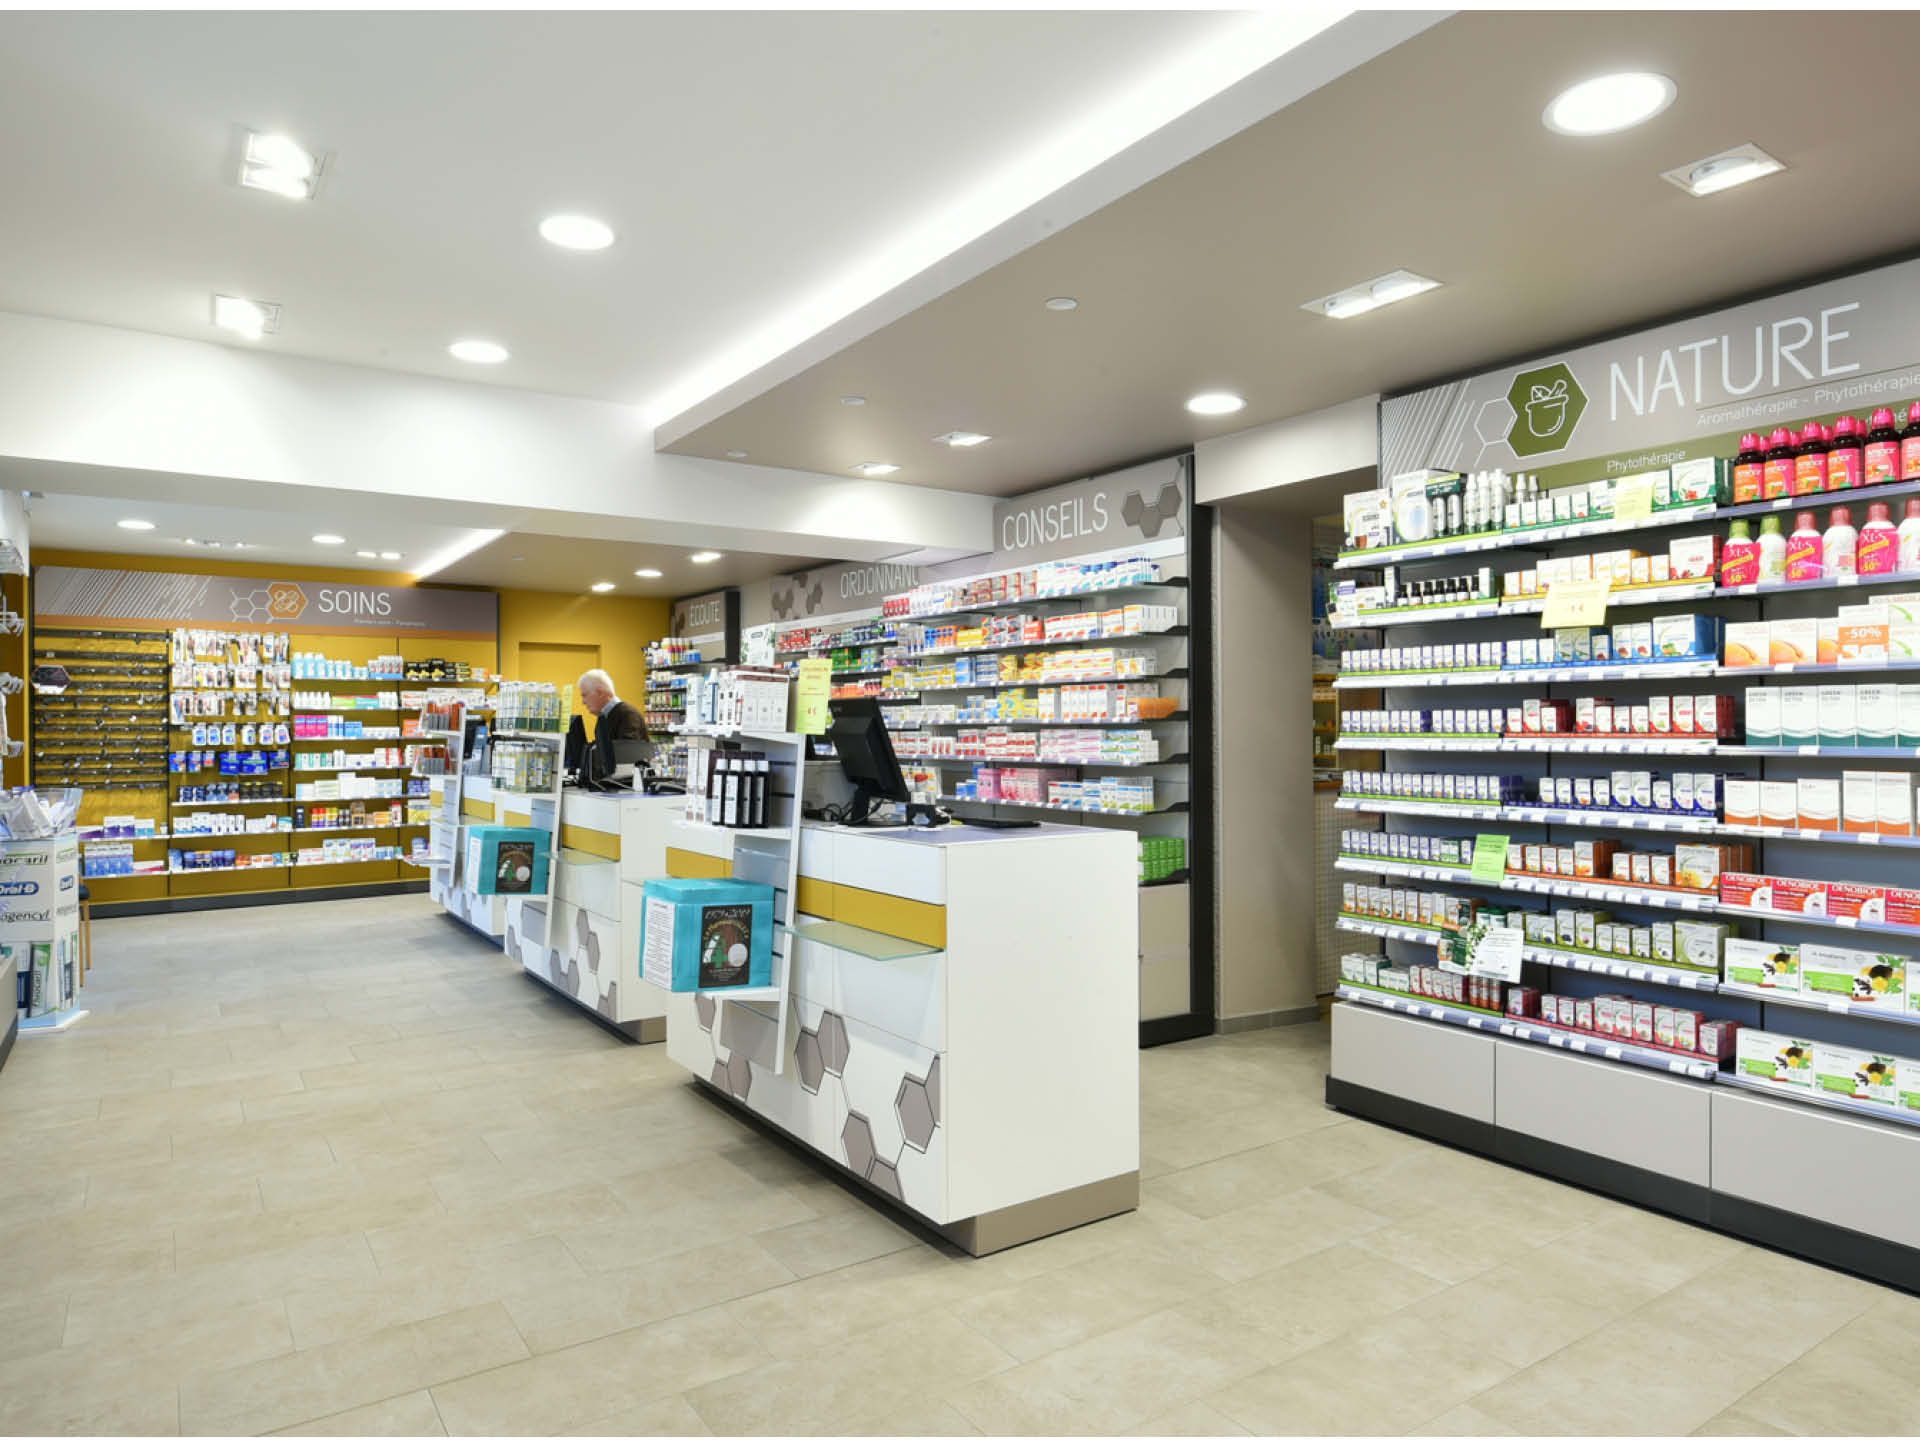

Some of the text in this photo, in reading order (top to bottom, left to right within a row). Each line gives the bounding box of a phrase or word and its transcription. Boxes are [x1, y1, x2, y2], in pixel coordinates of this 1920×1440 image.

[1610, 301, 1861, 421] NATURE
[1697, 398, 1799, 426] Aromathérapie
[1814, 372, 1920, 406] Phytothérapie
[1607, 450, 1686, 474] Phytothérapie
[1003, 492, 1109, 551] CONSEILS
[318, 589, 392, 616] SOINS
